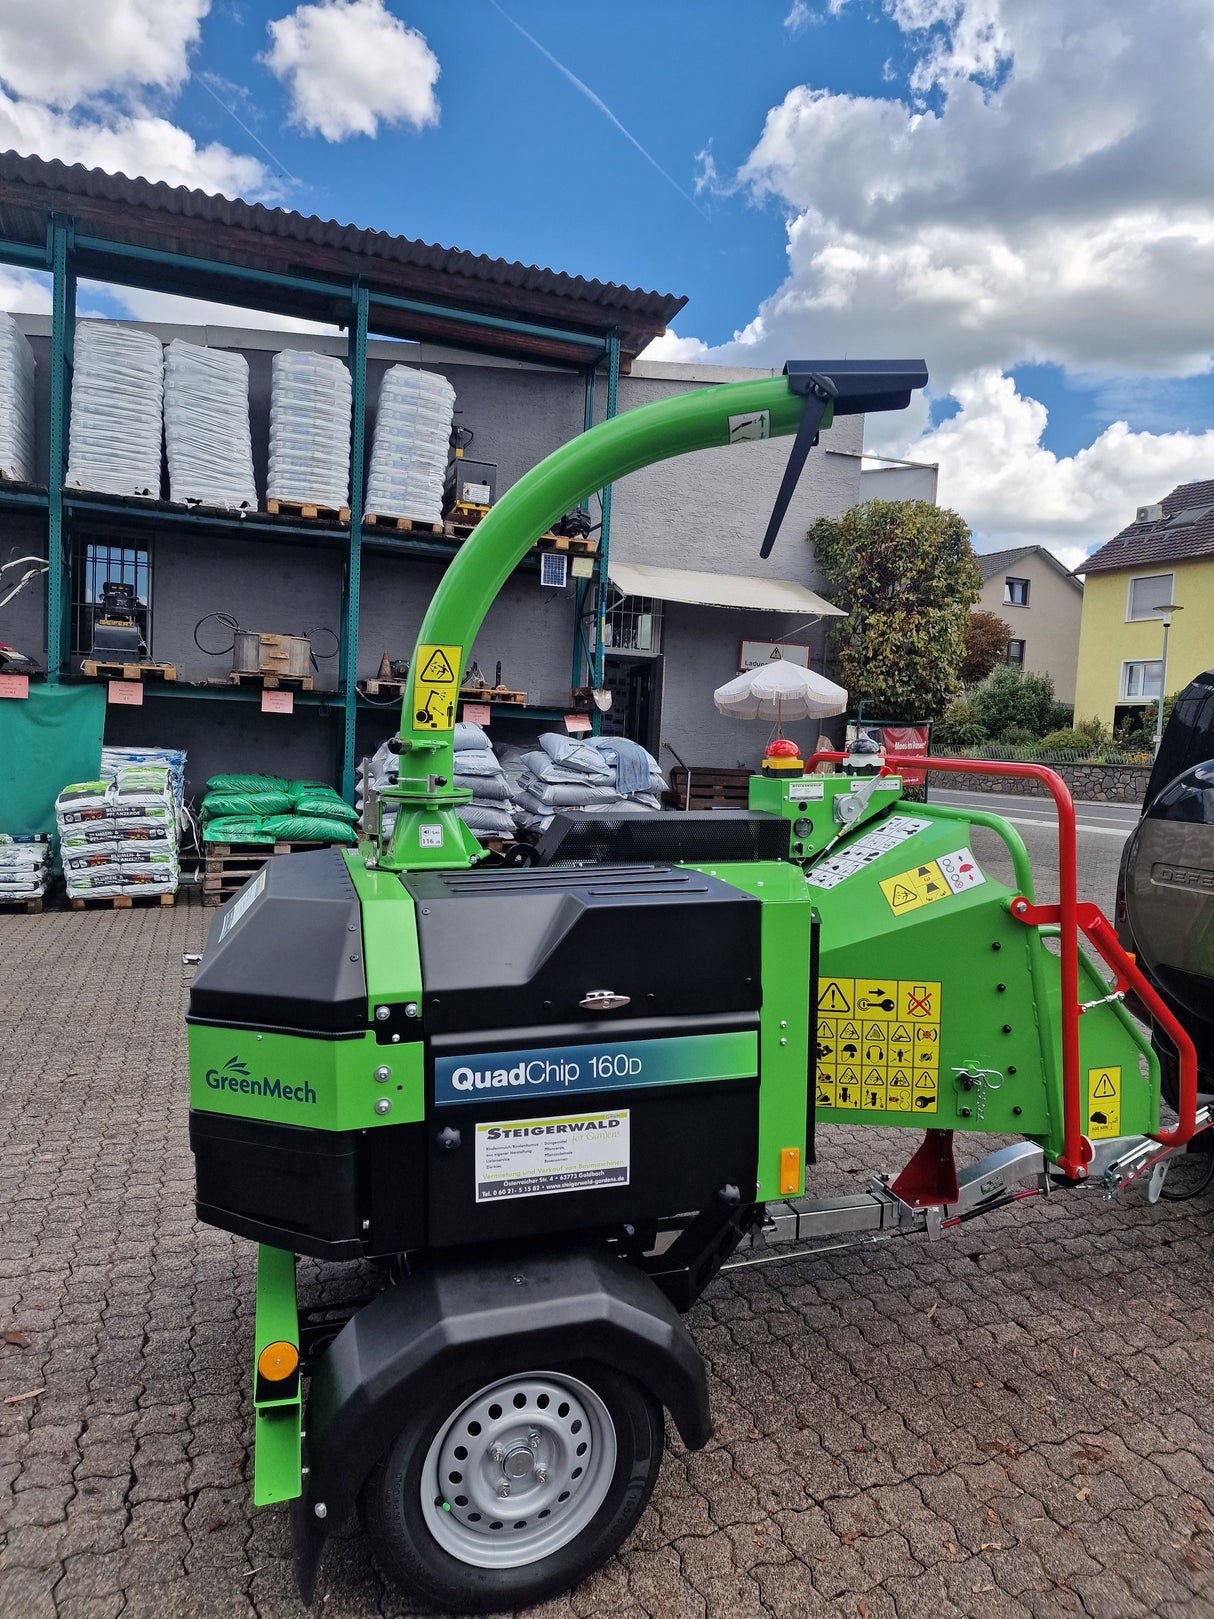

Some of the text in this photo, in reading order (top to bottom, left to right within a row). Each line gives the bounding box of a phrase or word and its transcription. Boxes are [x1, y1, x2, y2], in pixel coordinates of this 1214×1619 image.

[206, 1069, 316, 1104] GreenMech
[452, 1054, 642, 1091] QuadChip 160D
[488, 1120, 620, 1140] STEIGERWALD
